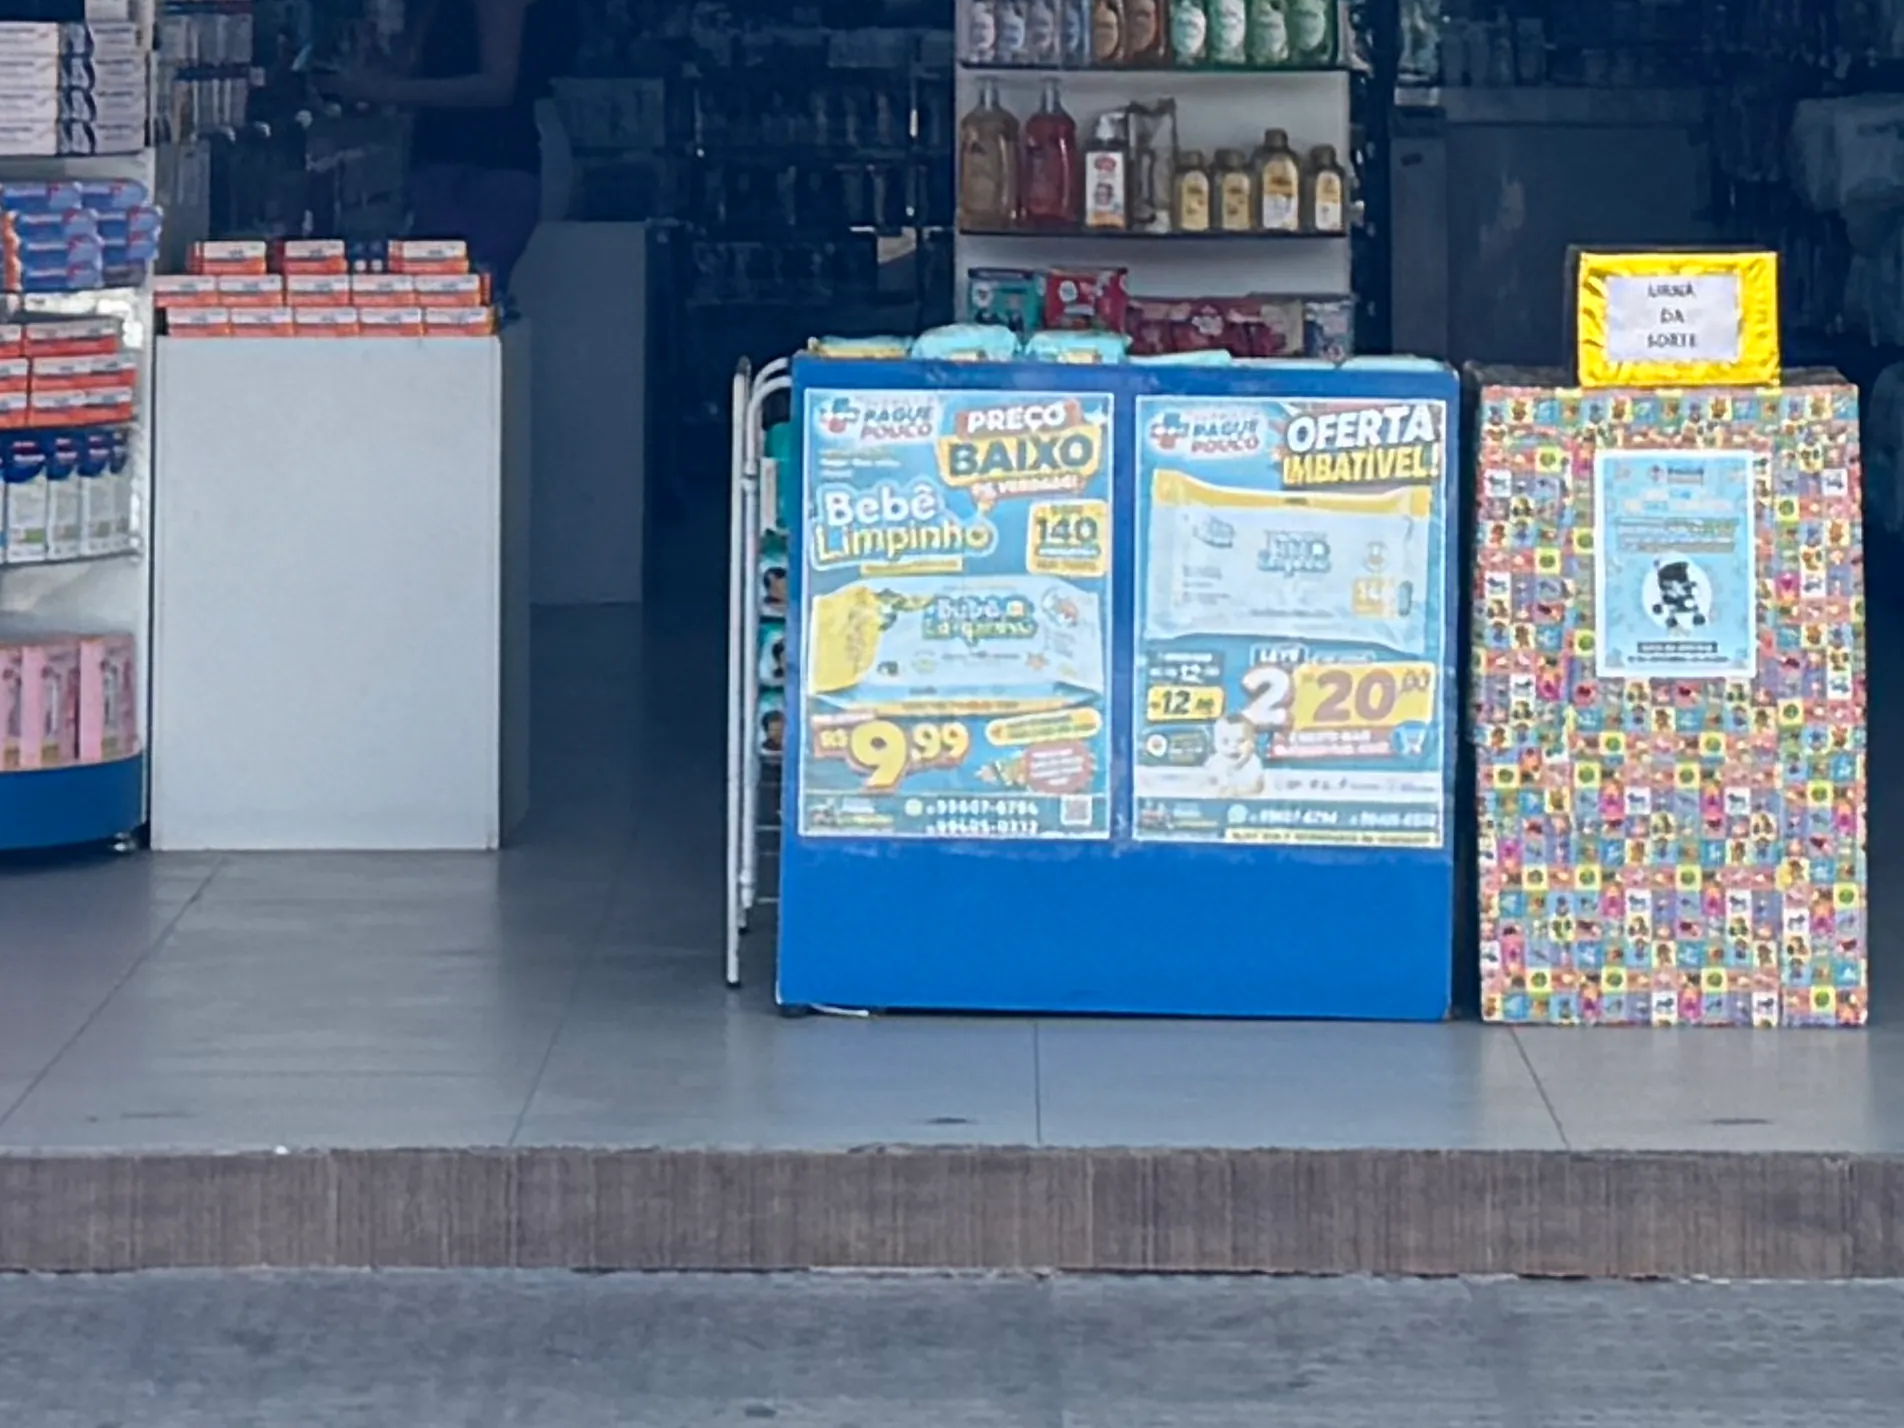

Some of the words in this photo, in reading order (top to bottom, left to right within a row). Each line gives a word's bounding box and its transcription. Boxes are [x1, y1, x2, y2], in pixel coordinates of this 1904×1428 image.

[967, 401, 1067, 434] PREÇO
[1286, 405, 1435, 453] OFERTA
[949, 432, 1095, 477] BAIXO
[1282, 442, 1439, 485] IMBATÍVEL!
[824, 483, 937, 527] Bebê
[814, 519, 991, 561] Limpinho
[1036, 515, 1098, 544] 140
[1241, 665, 1291, 726] 2
